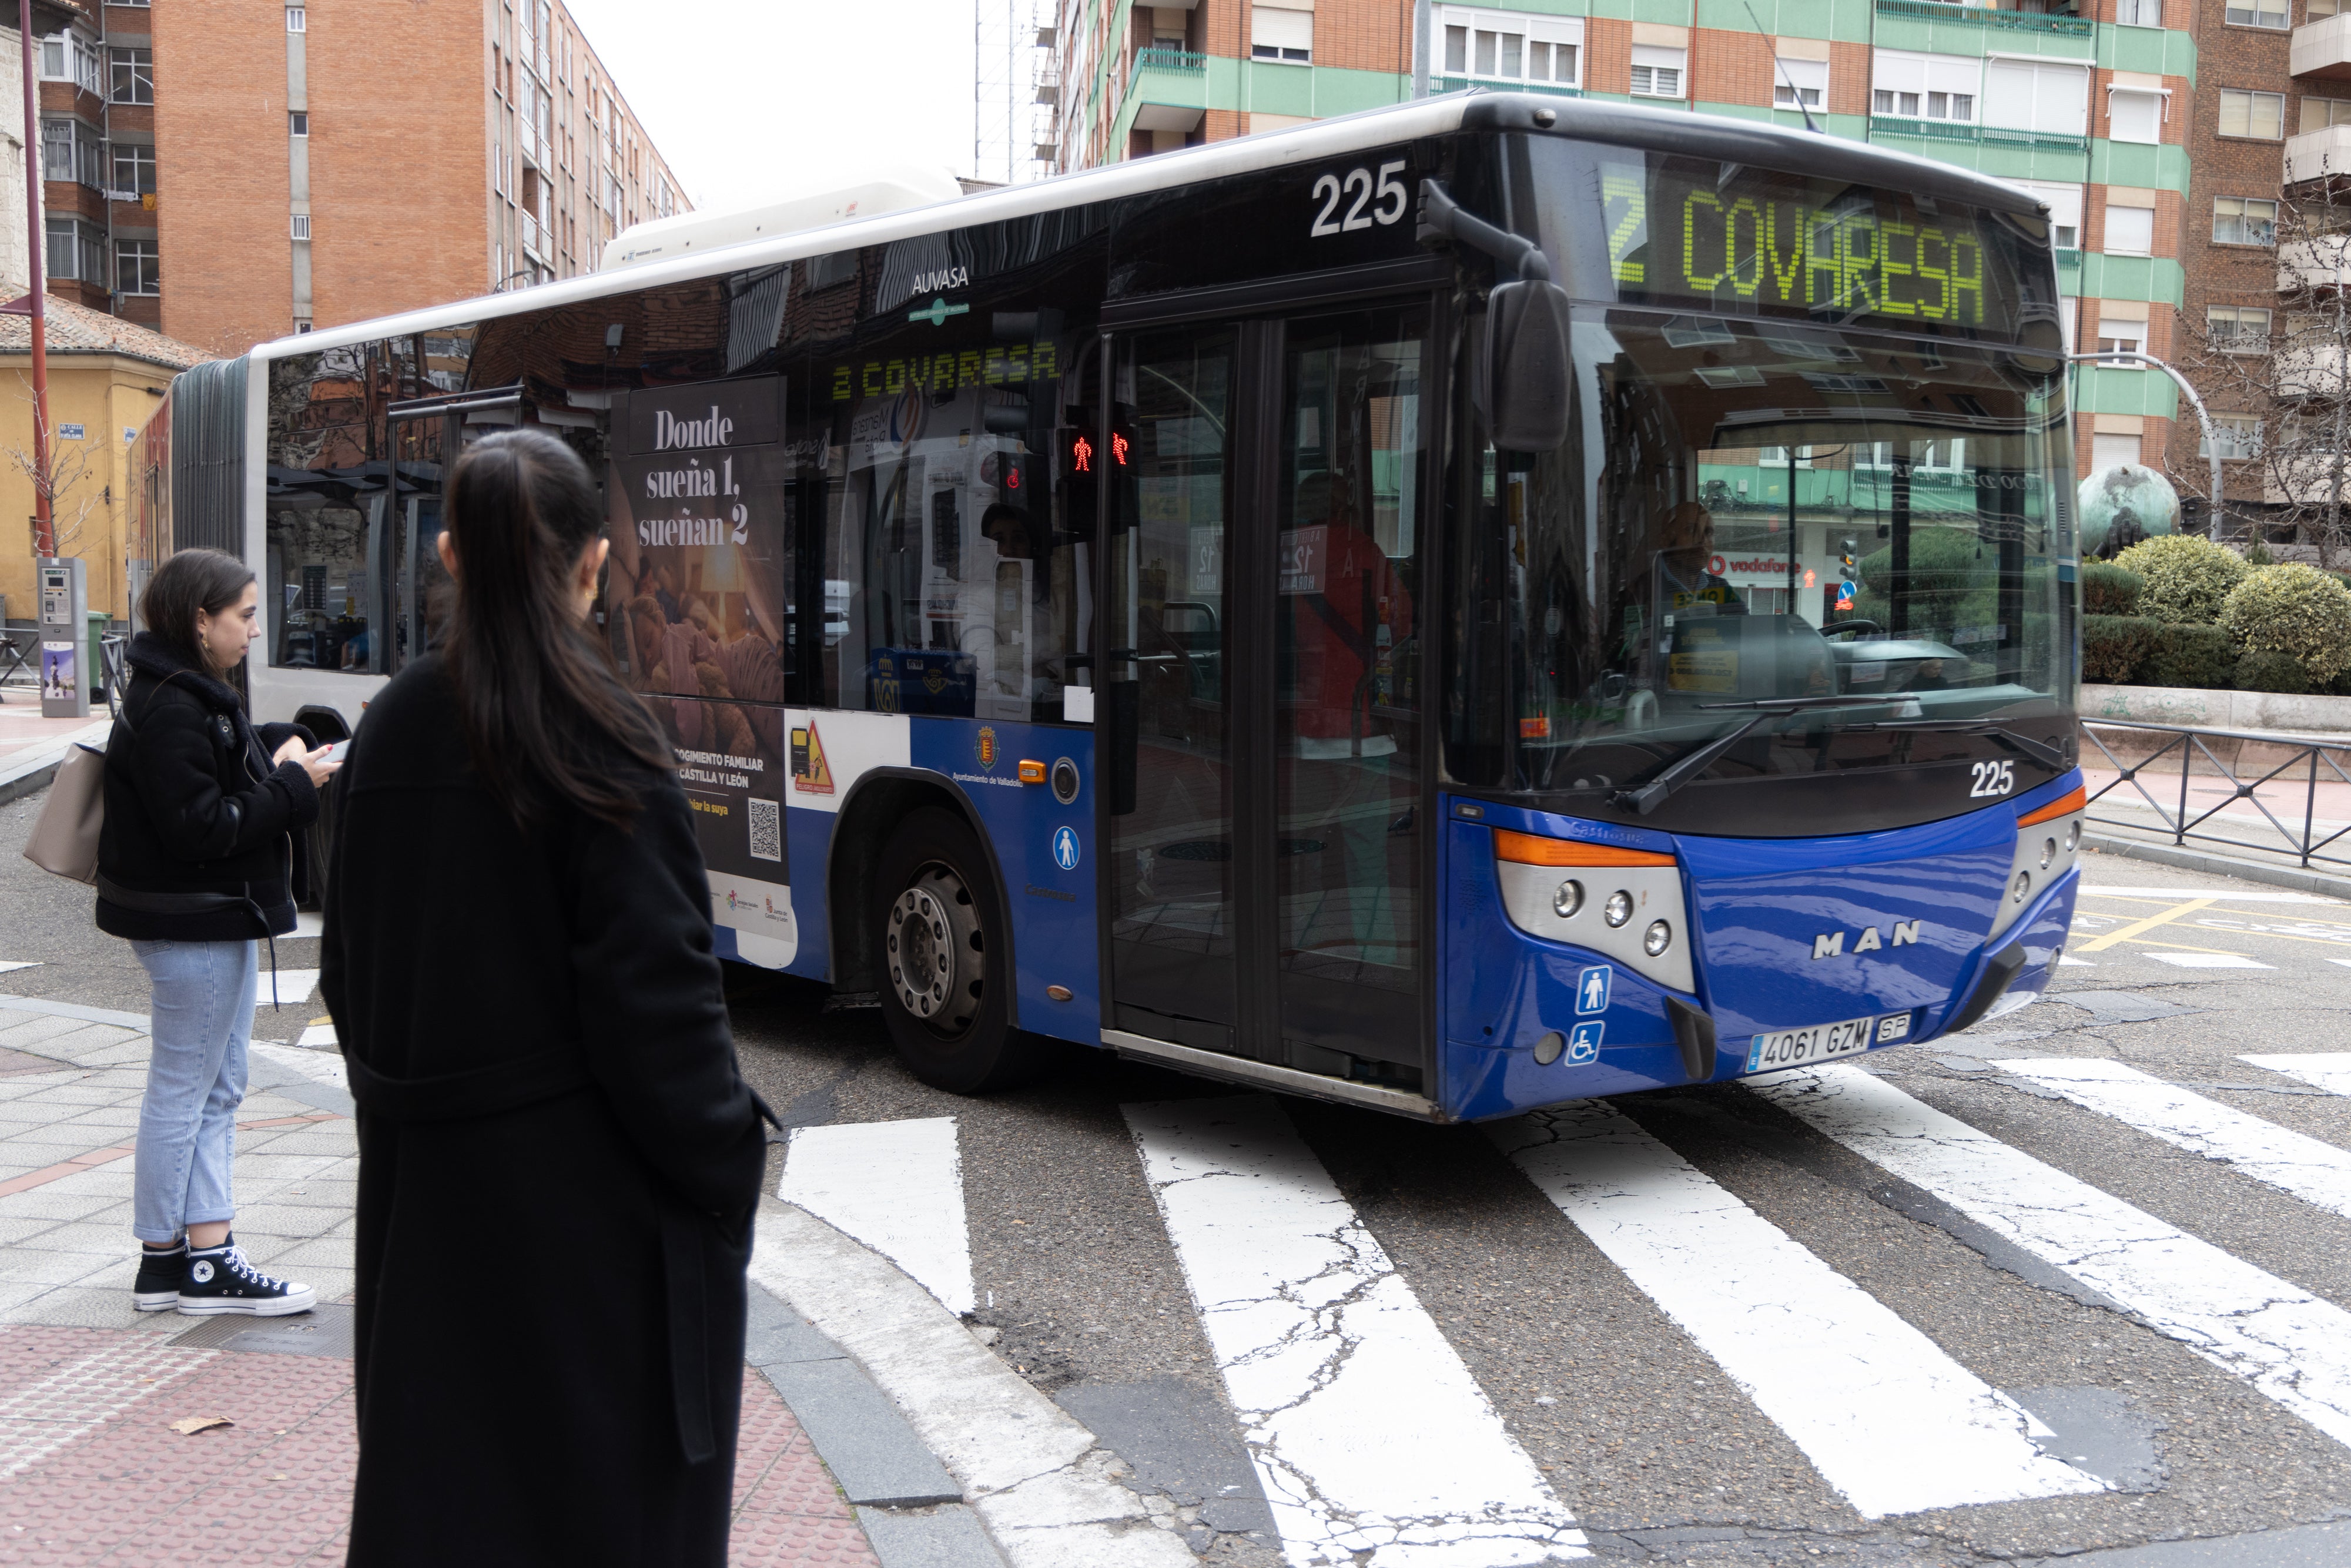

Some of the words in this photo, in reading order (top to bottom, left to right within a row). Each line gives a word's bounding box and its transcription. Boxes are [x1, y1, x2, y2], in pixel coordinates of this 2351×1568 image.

[1311, 159, 1407, 238] 225
[1602, 176, 1646, 283] 2
[1682, 188, 1984, 324] COVARESA
[912, 266, 969, 295] AUVASA
[833, 366, 852, 401] 2
[862, 341, 1061, 398] COVARESA
[654, 406, 734, 451] Donde
[647, 458, 718, 499] sueña
[723, 455, 741, 501] 1,
[639, 508, 725, 547] sueñan
[731, 503, 749, 545] 2
[674, 748, 723, 766] COGIMIENTO
[724, 755, 763, 772] FAMILIAR
[679, 768, 718, 784] CASTILLA
[718, 773, 725, 785] Y
[726, 772, 749, 789] LEÓN
[953, 772, 989, 784] Ayuntamiento
[989, 776, 997, 785] de
[1970, 759, 2014, 799] 225
[704, 800, 710, 812] la
[711, 802, 728, 816] suya
[1811, 918, 1922, 961] MAN
[1750, 1057, 1757, 1065] E
[1764, 1029, 1819, 1064] 4061
[1826, 1019, 1868, 1054] GZM
[1880, 1017, 1907, 1038] SP
